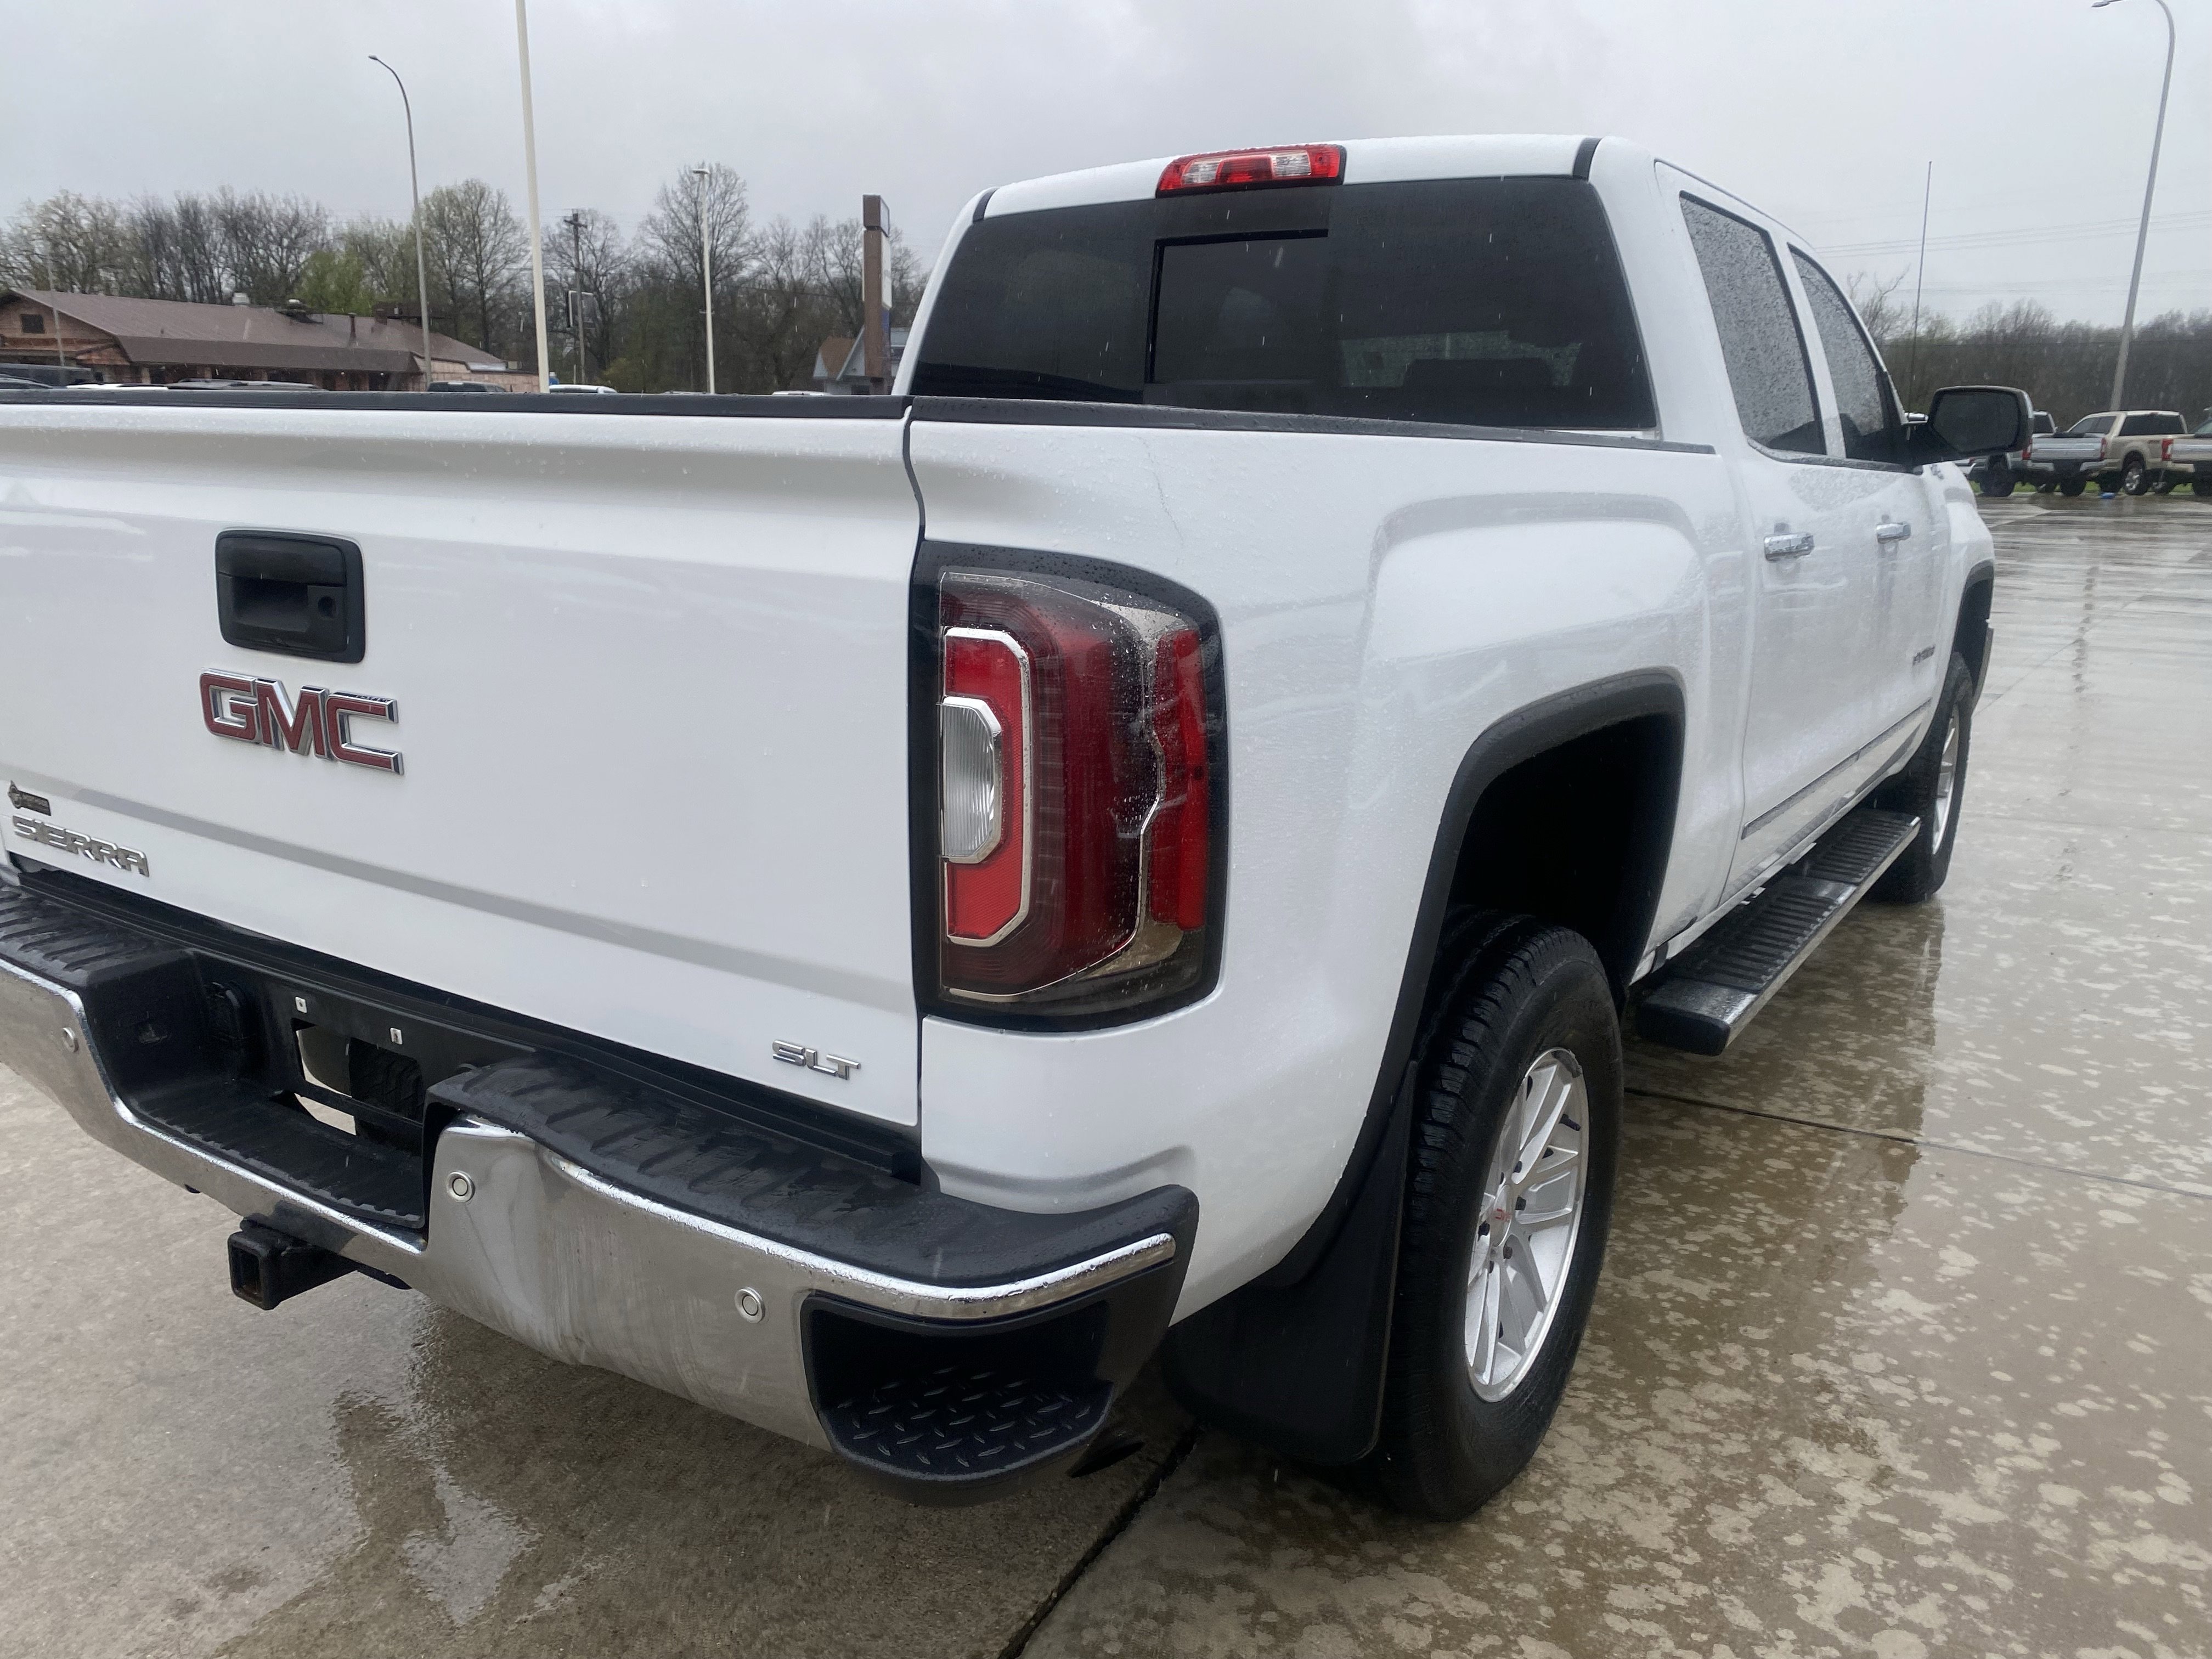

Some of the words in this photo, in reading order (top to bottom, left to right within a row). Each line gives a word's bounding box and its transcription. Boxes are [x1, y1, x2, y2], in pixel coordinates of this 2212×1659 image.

[200, 668, 404, 775] GMC
[13, 814, 149, 877] SIERRA
[772, 1040, 861, 1080] SLT
